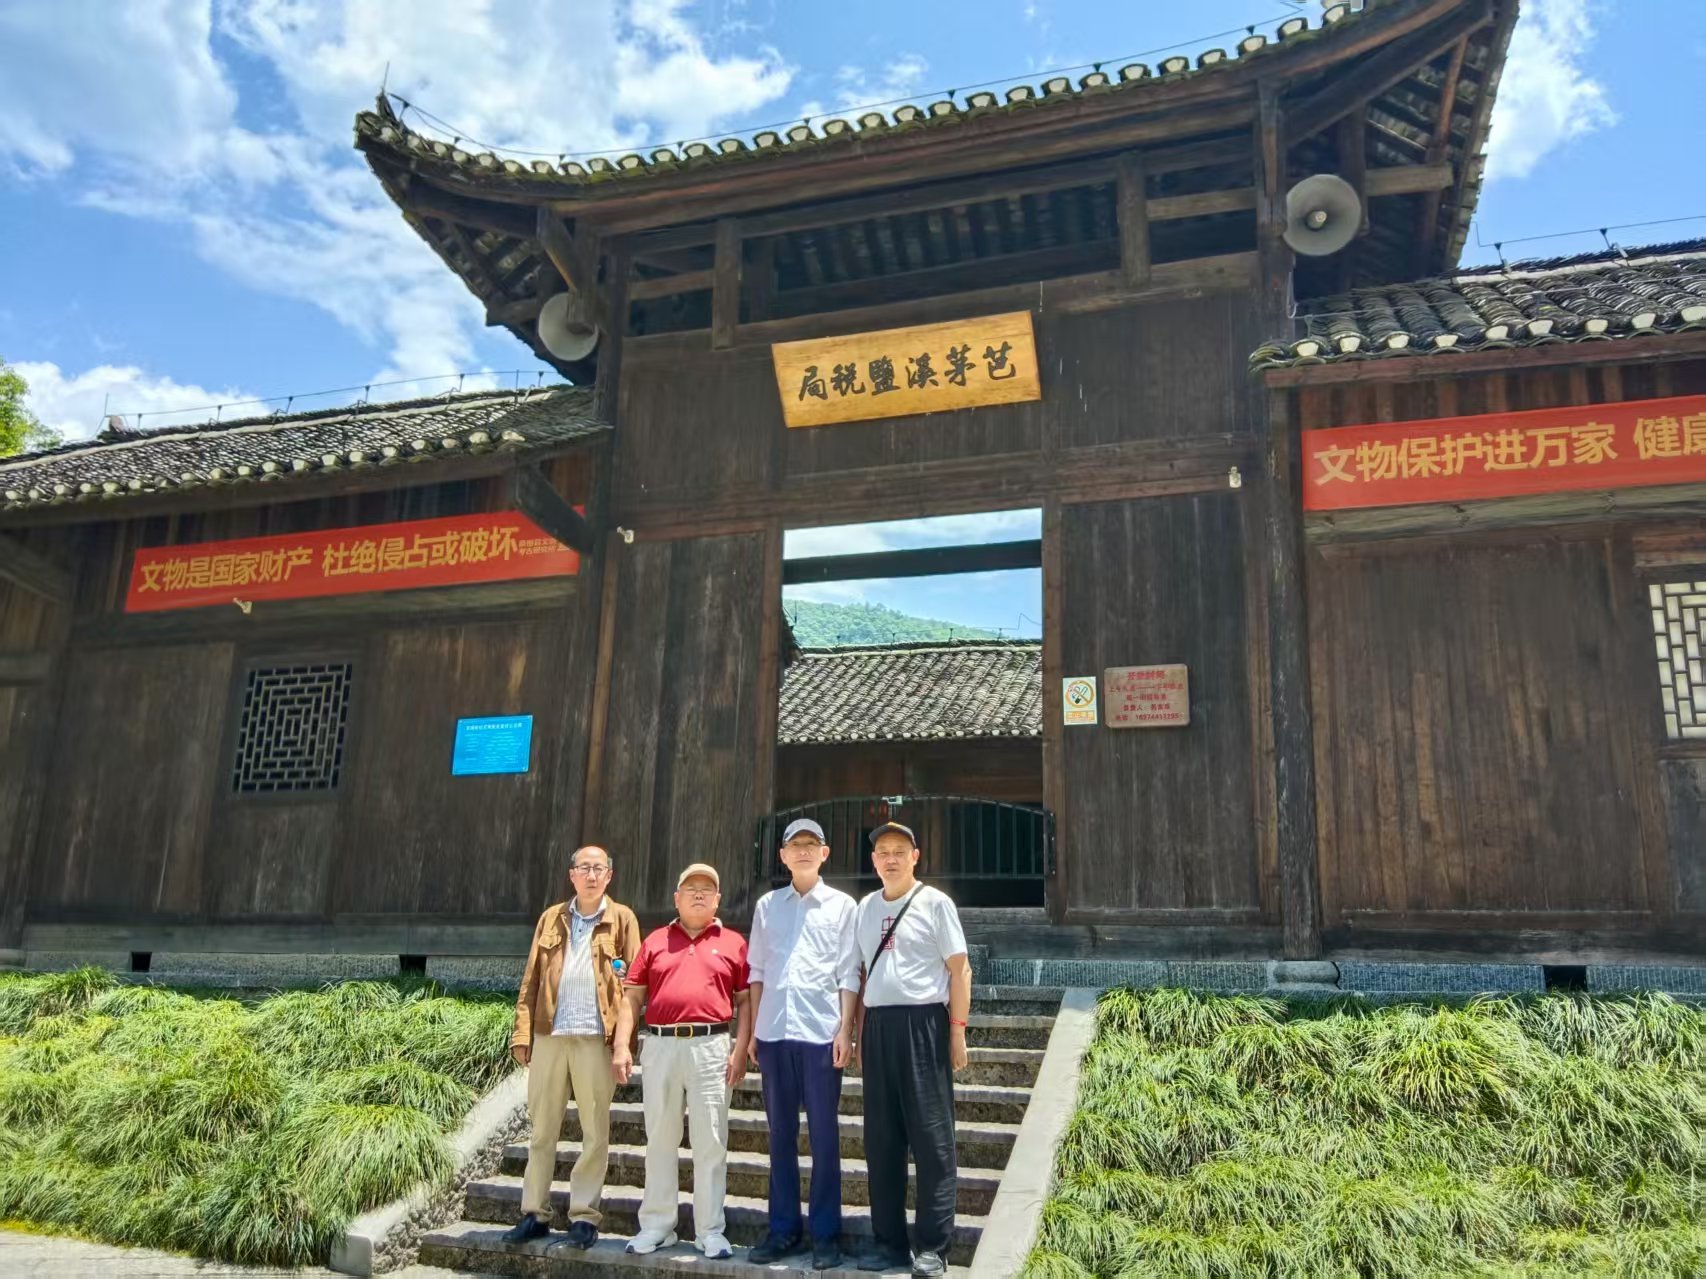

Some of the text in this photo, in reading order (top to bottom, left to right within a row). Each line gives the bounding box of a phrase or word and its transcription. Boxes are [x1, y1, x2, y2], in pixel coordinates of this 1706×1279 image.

[1313, 421, 1618, 486] 文物保护进万家
[137, 525, 520, 593] 文物是国家财产 杜绝侵占或破坏
